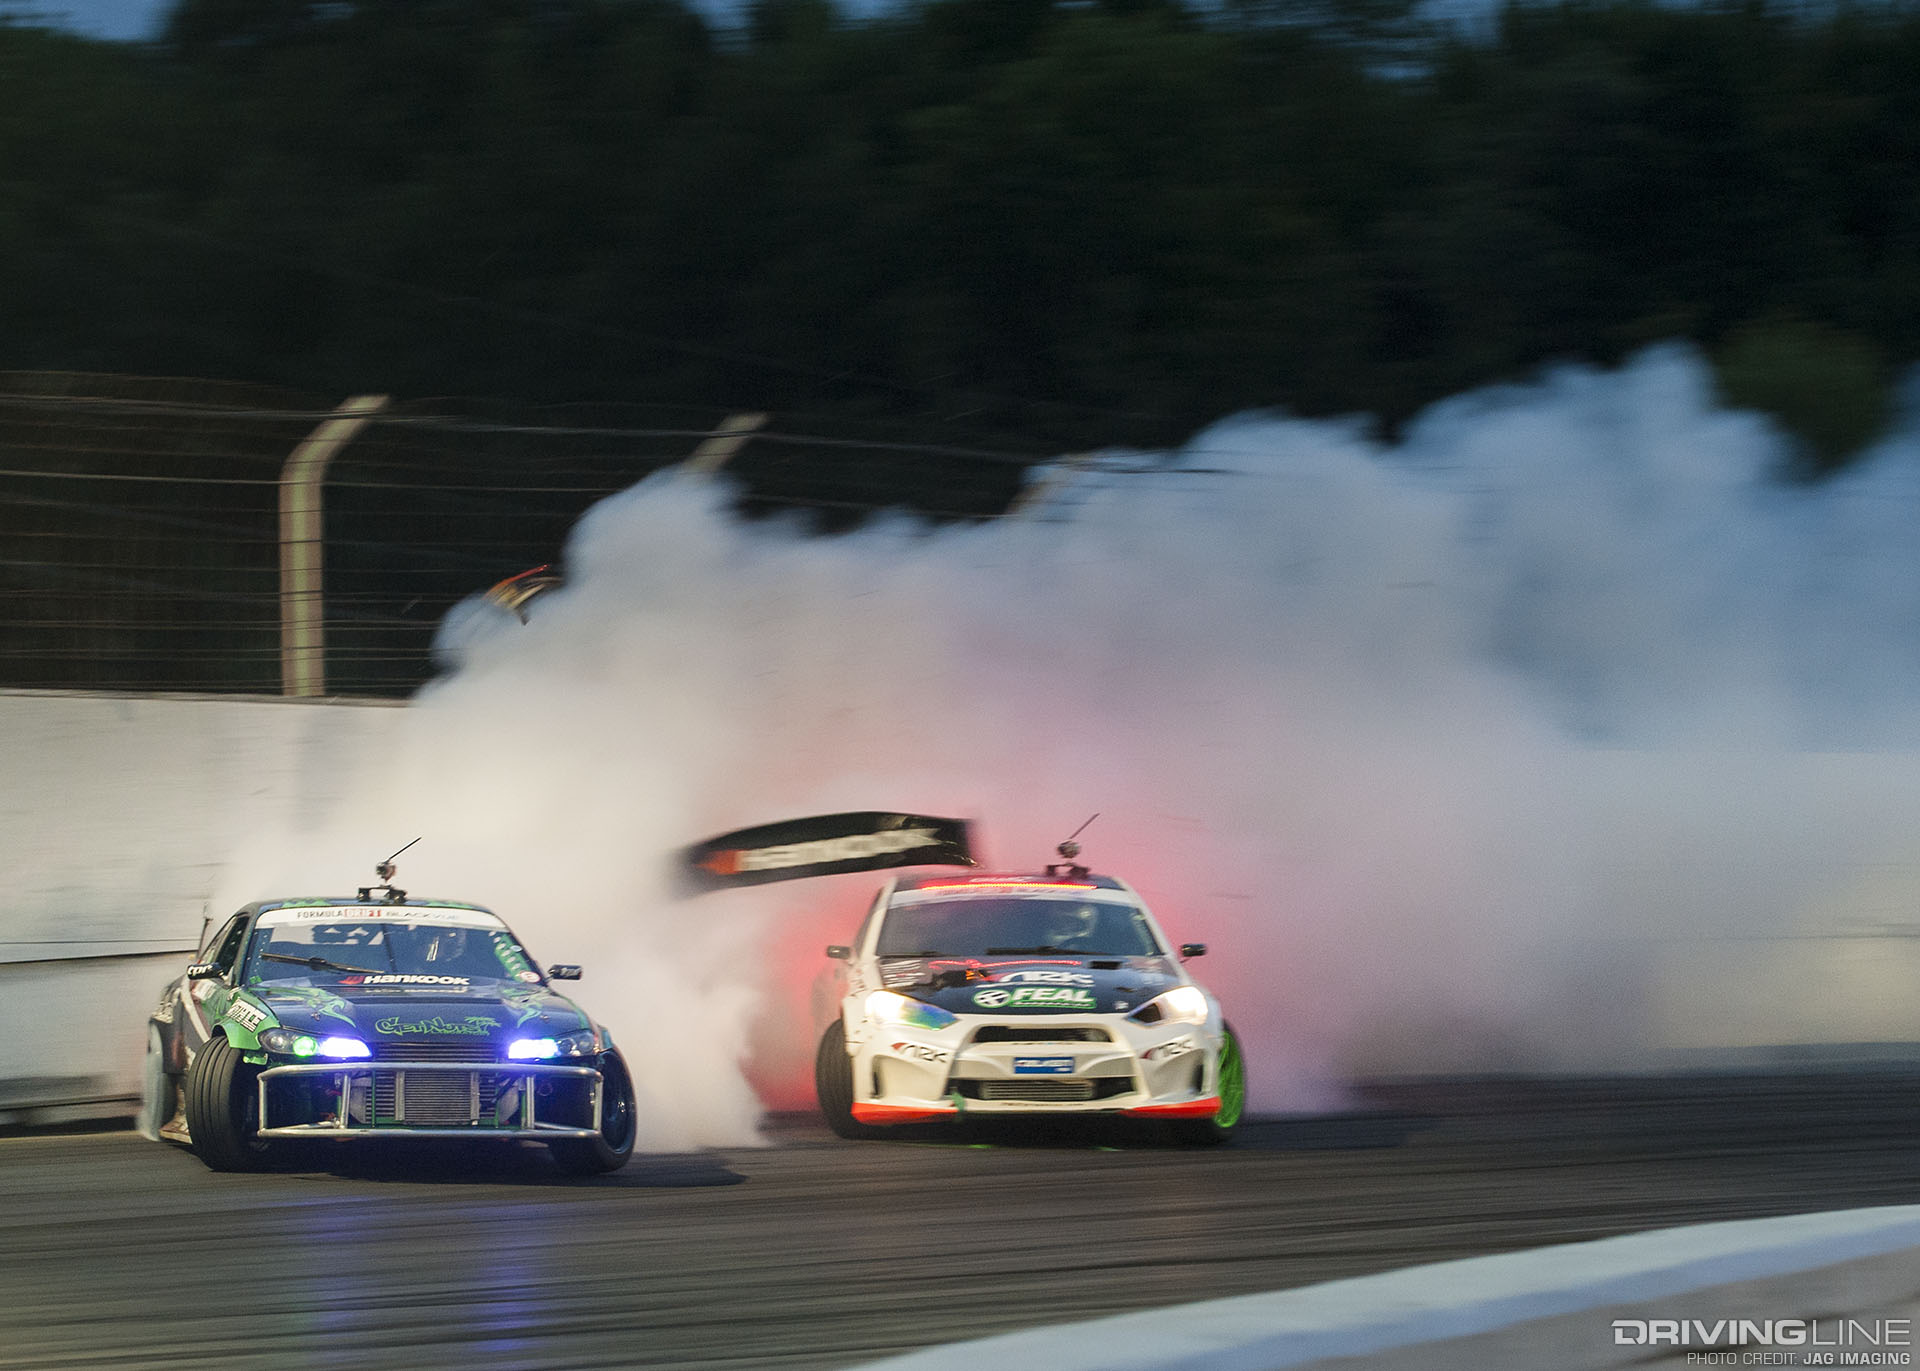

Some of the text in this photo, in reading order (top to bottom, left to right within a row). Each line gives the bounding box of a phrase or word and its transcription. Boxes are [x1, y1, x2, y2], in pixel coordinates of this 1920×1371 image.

[297, 910, 343, 919] FORMULA
[344, 908, 382, 918] DRIFT
[1013, 987, 1095, 1002] FEAL
